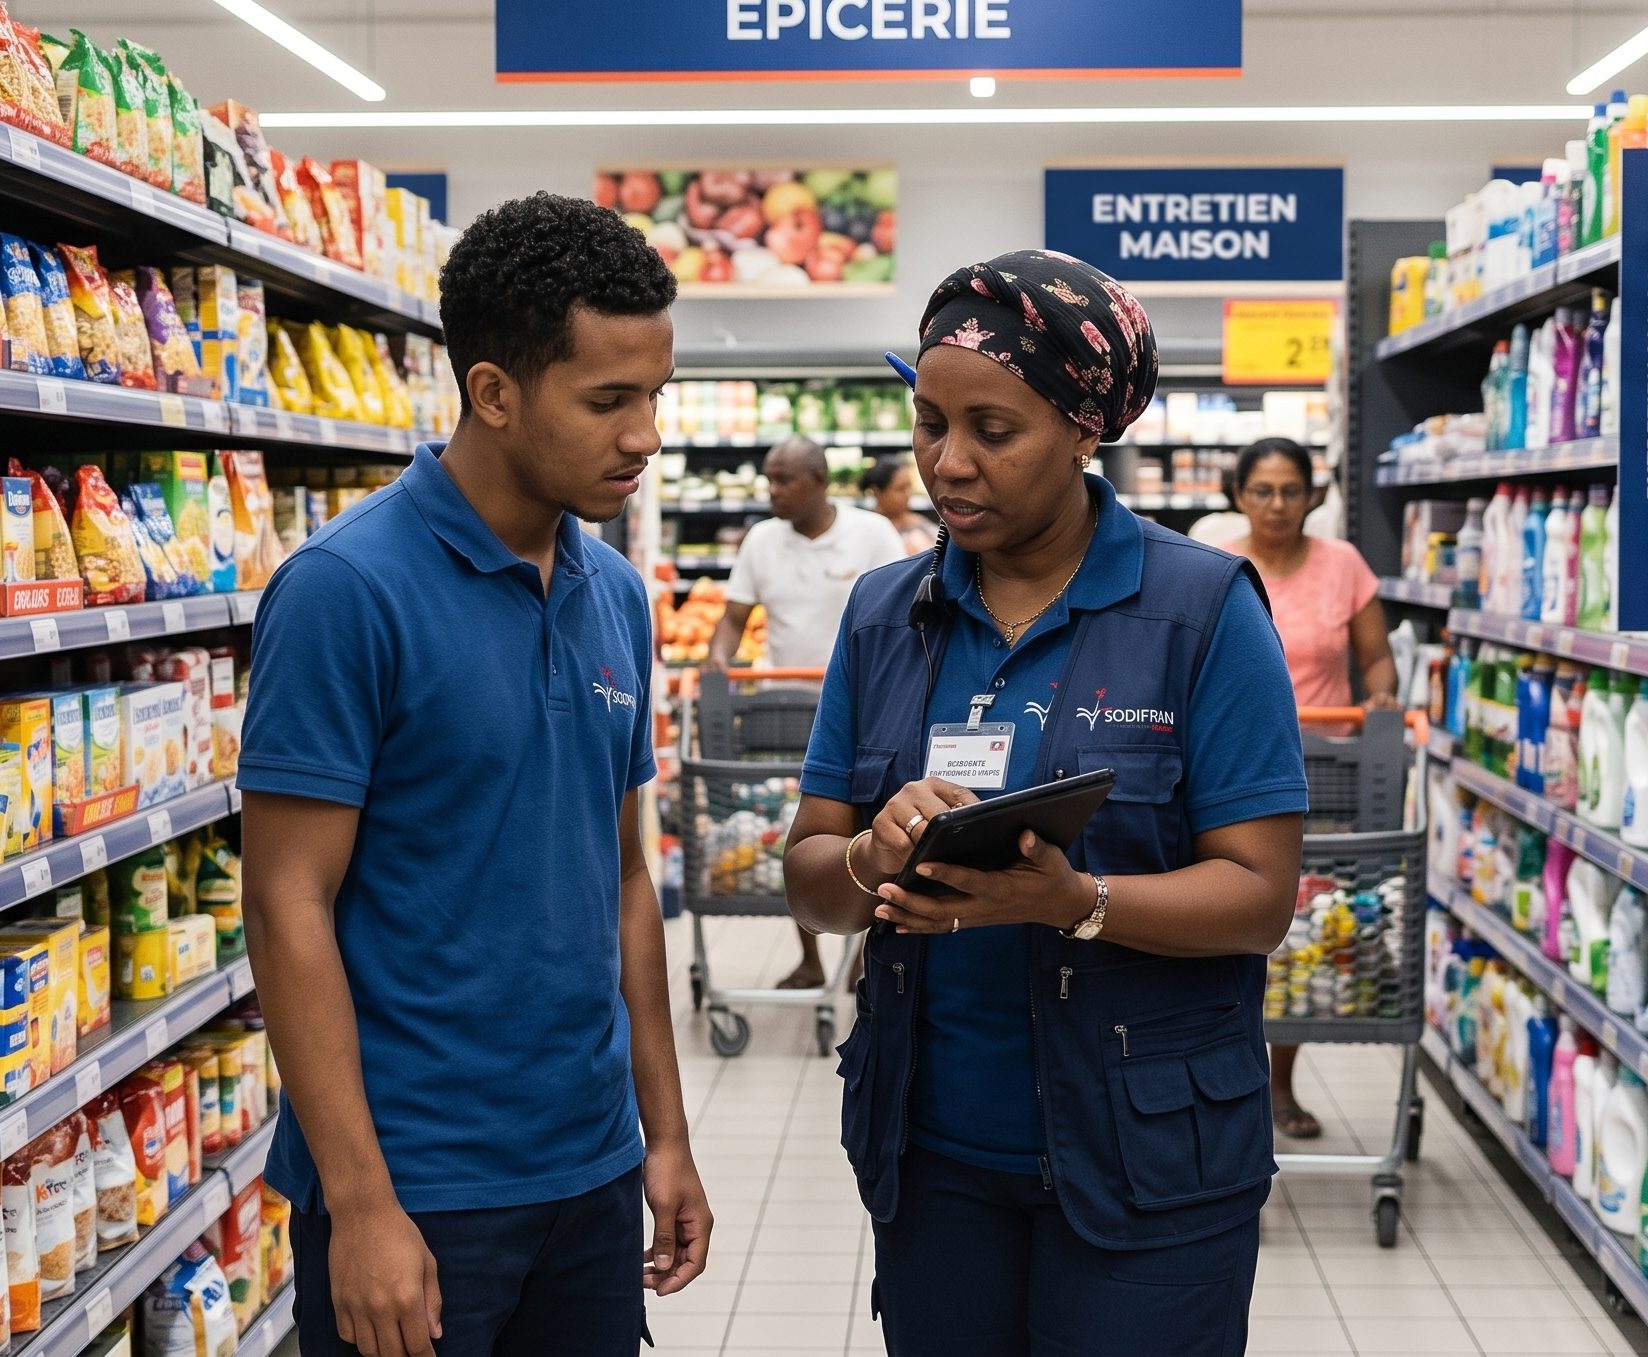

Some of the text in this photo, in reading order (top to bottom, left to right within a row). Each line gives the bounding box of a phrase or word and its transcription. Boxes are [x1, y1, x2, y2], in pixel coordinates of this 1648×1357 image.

[1092, 193, 1298, 223] ENTRETIEN
[1119, 230, 1270, 260] MAISON
[1286, 337, 1304, 369] 2
[1104, 708, 1175, 725] SODIFRAN
